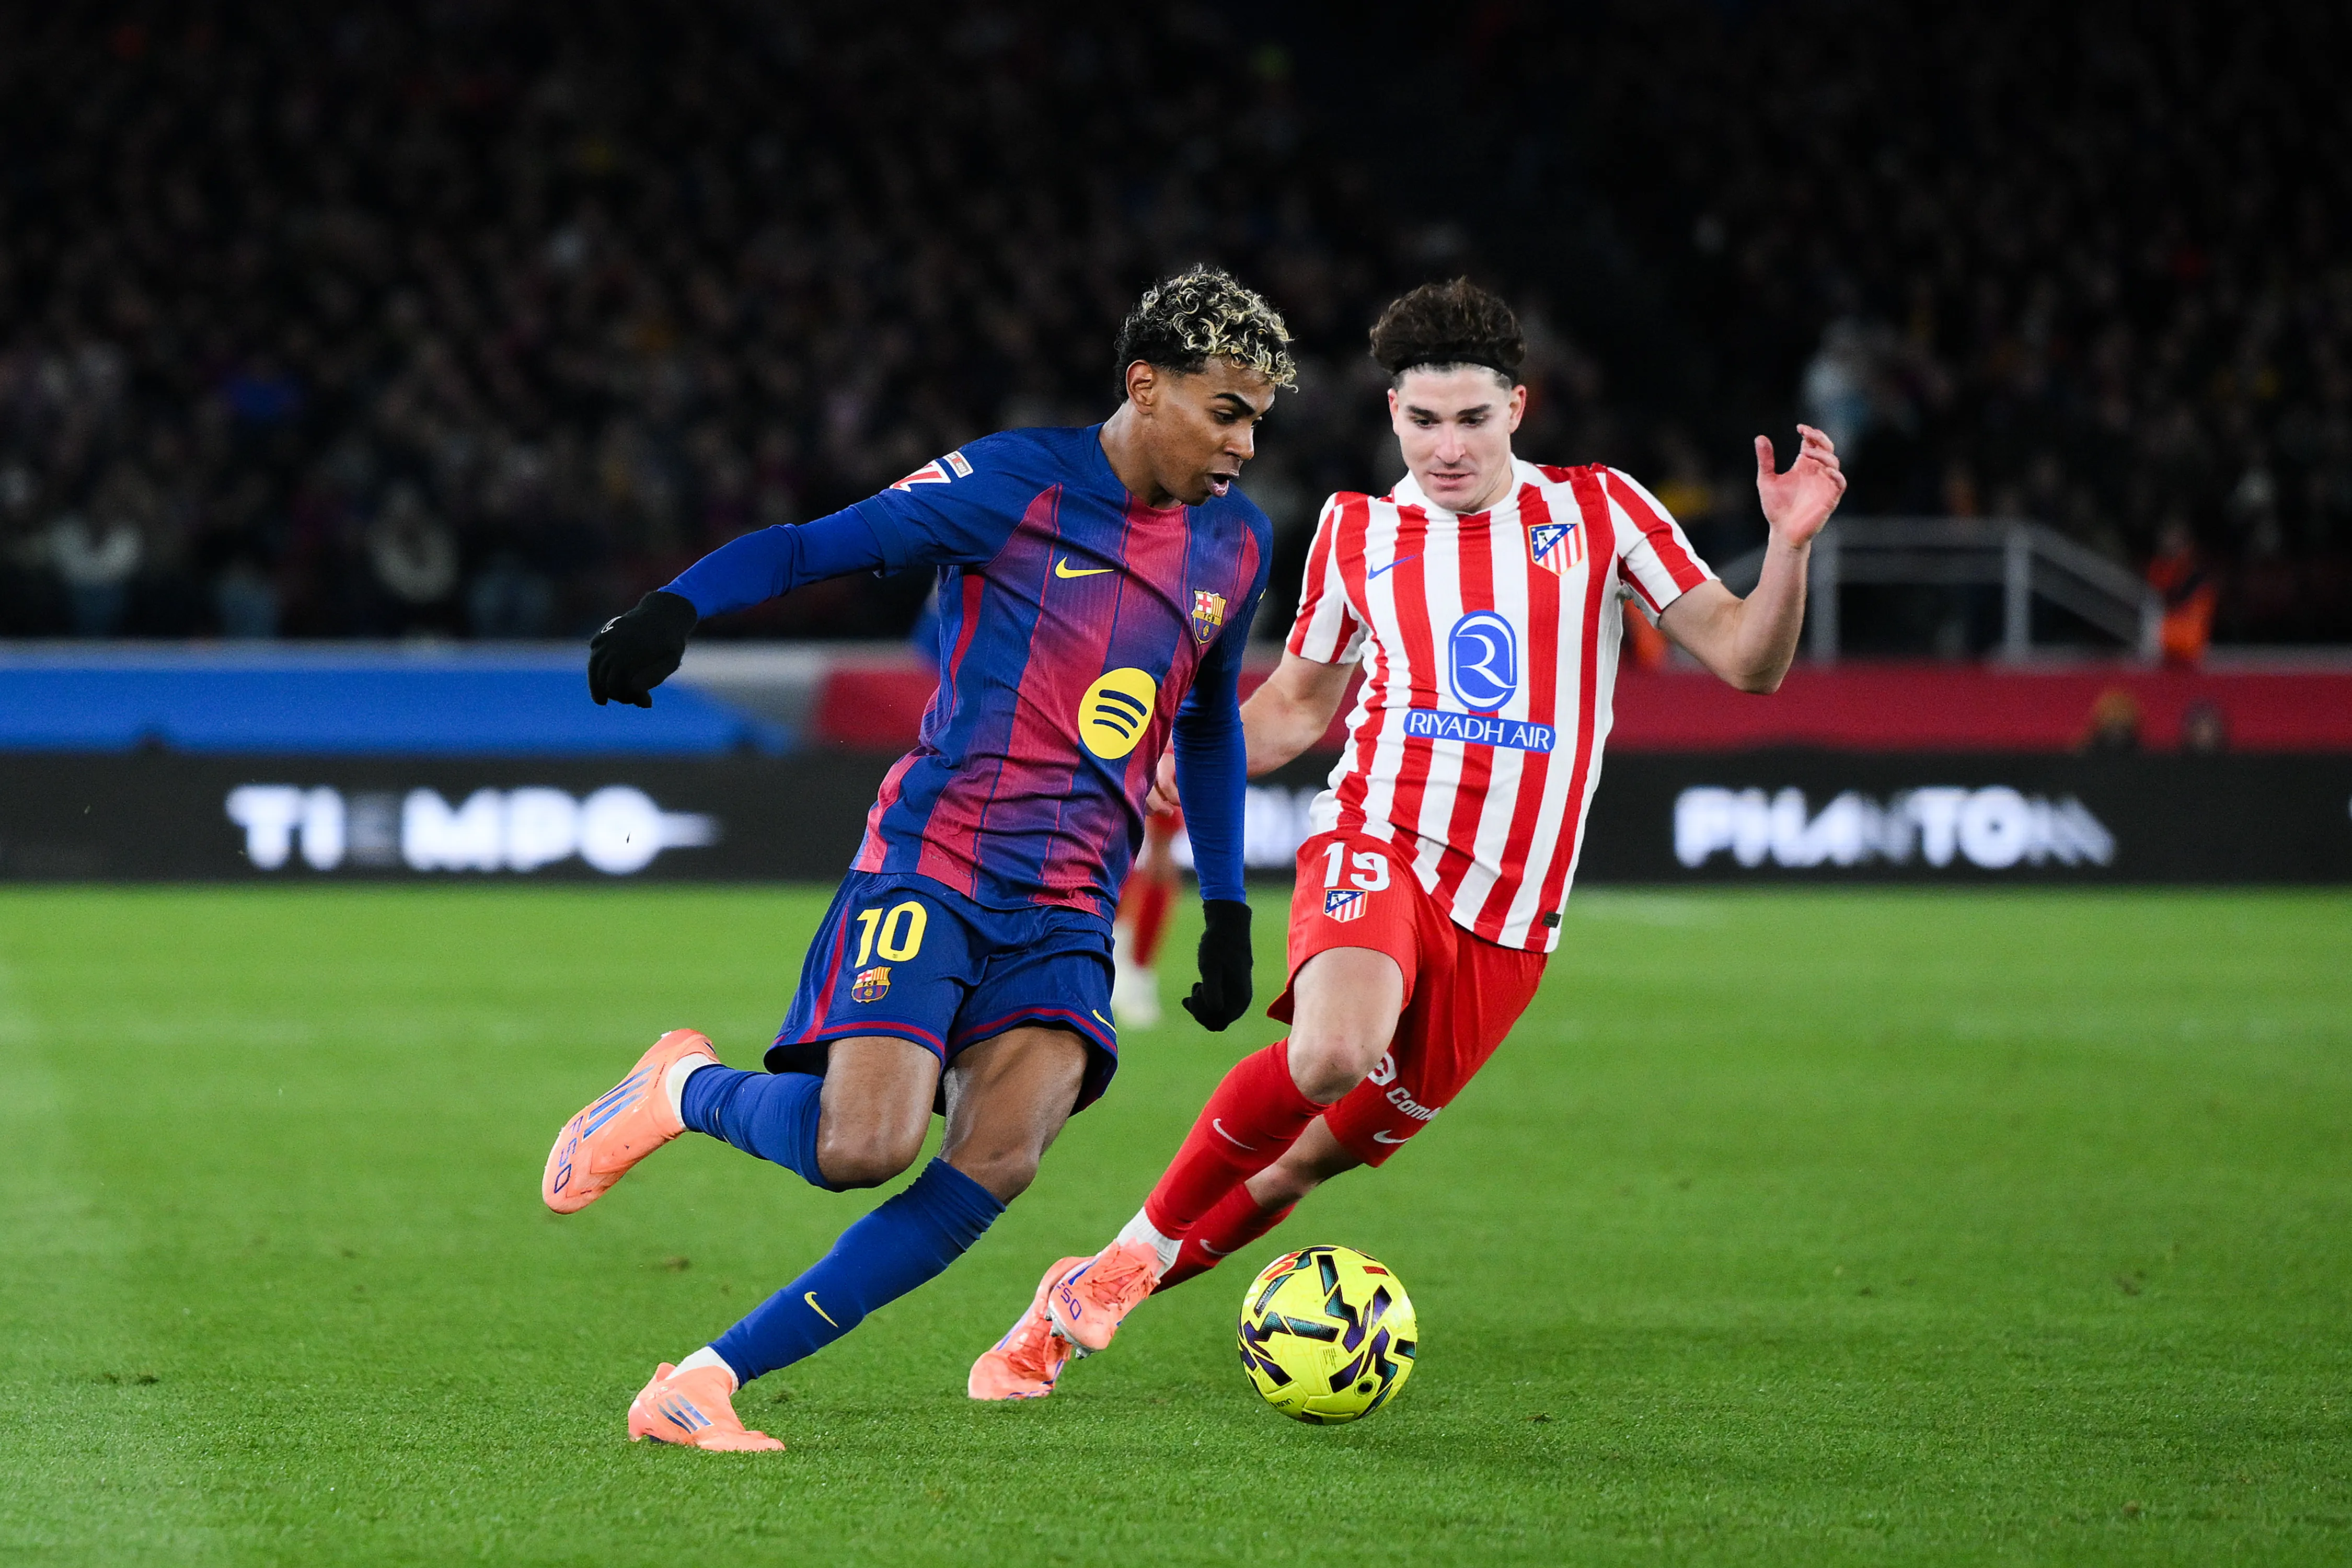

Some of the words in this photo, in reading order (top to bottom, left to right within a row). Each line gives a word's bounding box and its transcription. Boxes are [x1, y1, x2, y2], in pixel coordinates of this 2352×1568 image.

[1203, 614, 1215, 622] FCB
[1410, 712, 1504, 743] RIYADH
[1510, 725, 1550, 751] AIR
[1322, 842, 1391, 892] 19
[855, 901, 927, 968] 10
